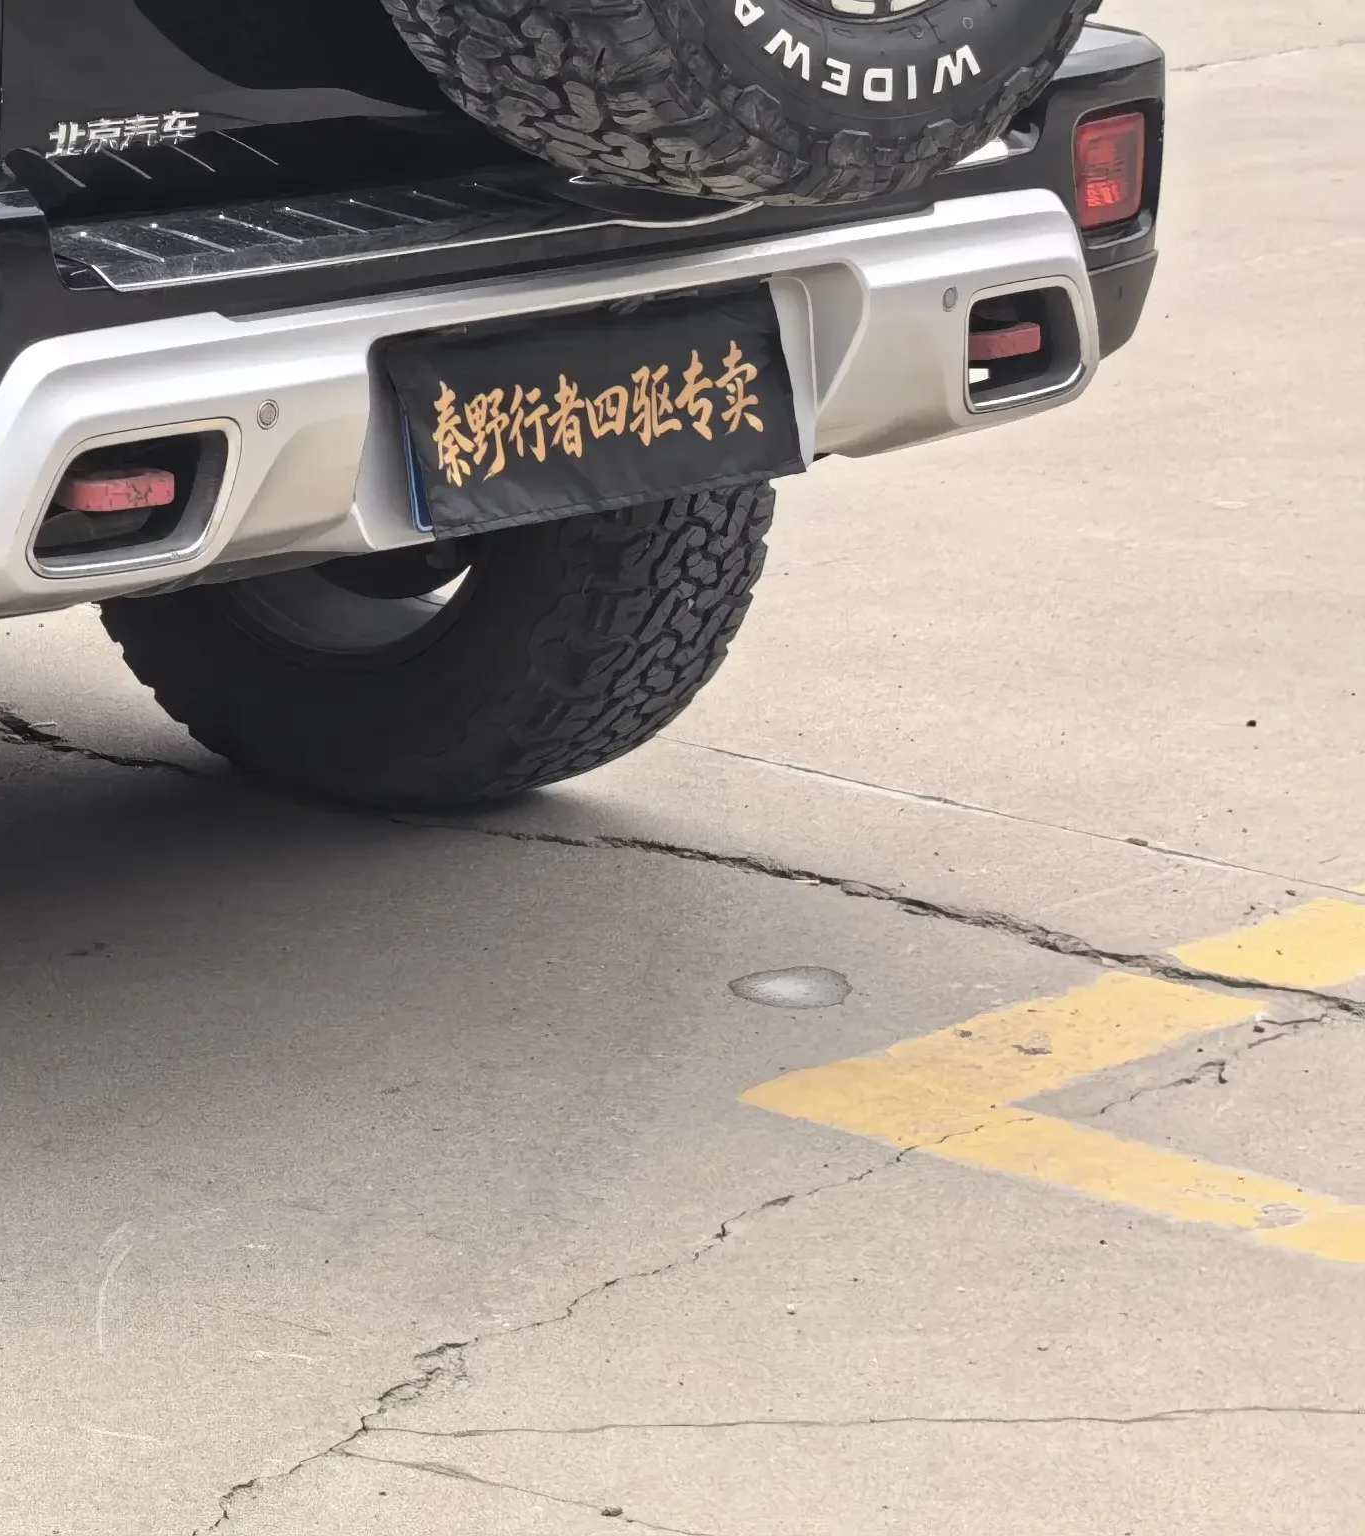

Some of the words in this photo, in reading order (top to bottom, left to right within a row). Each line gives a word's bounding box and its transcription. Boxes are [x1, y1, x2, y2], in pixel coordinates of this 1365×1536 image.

[45, 110, 200, 159] 北京汽车
[431, 340, 764, 487] 秦野行者四驱专卖
